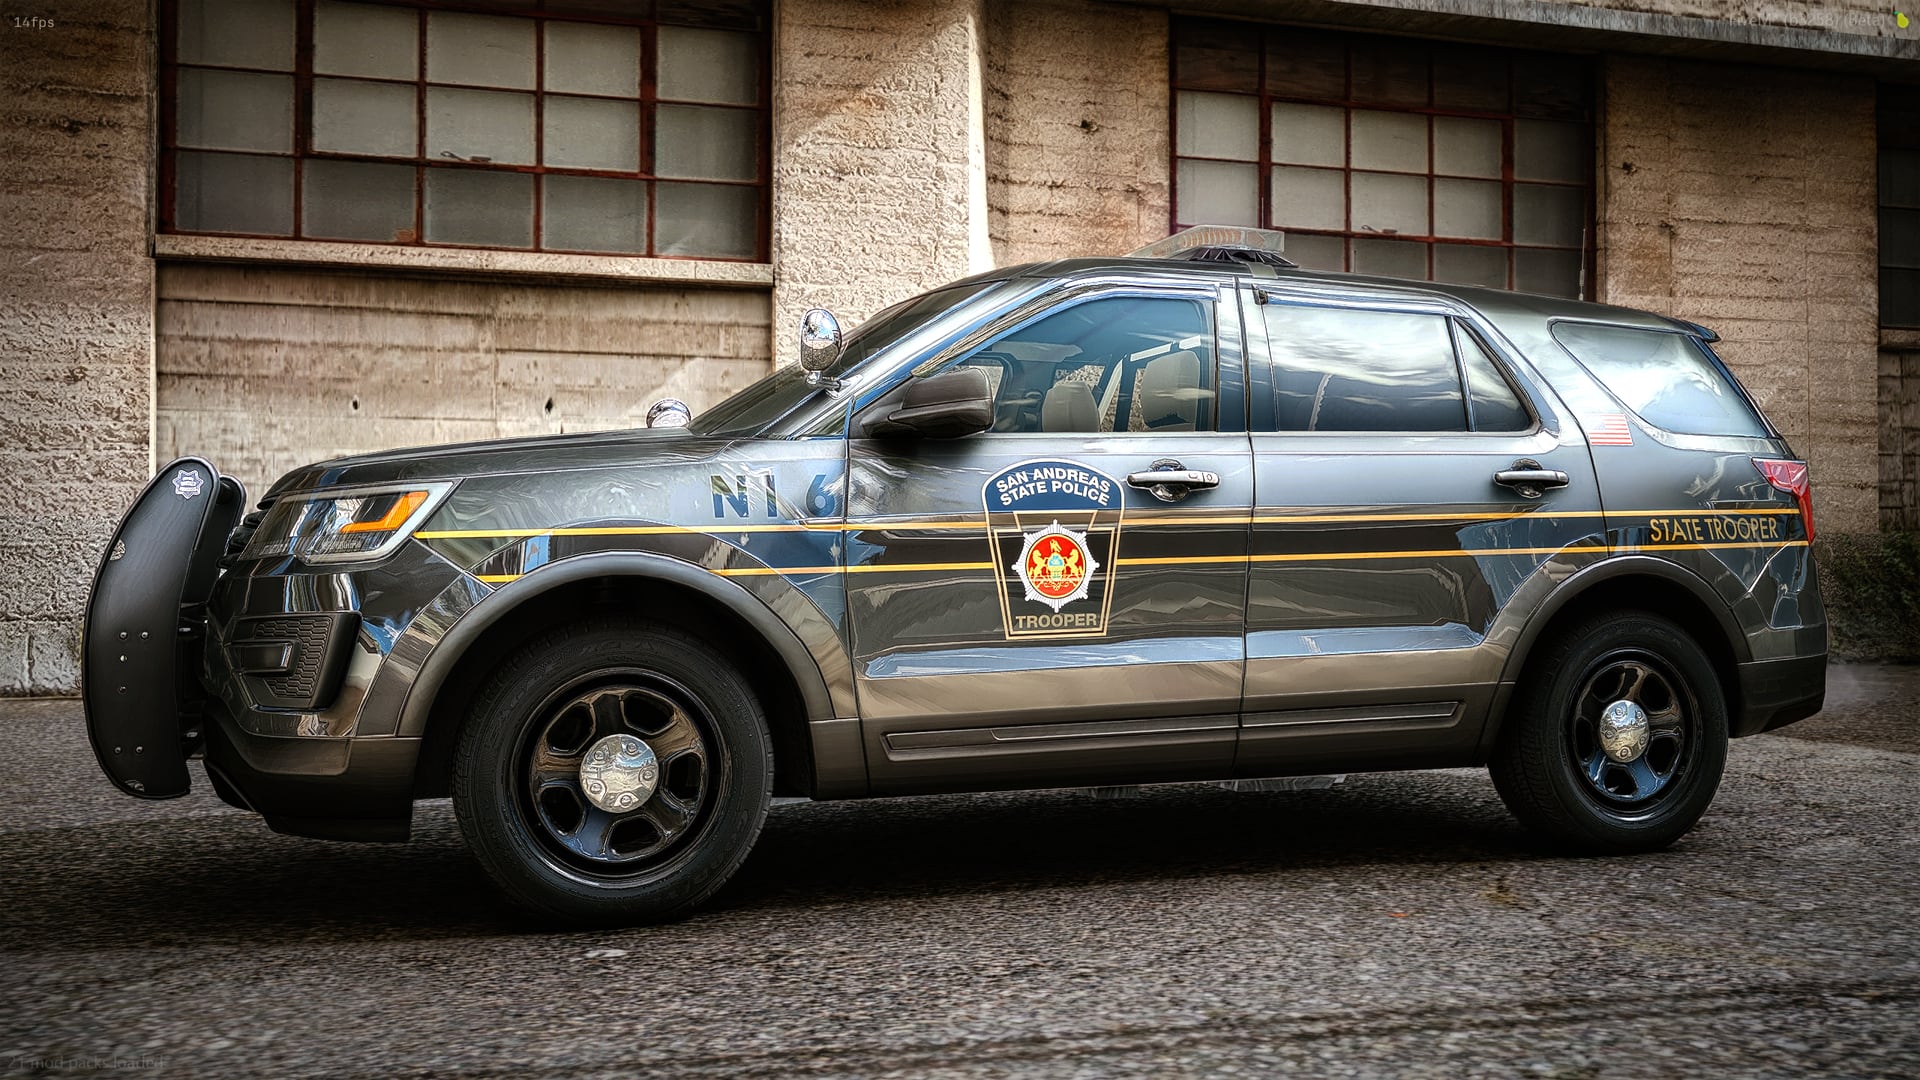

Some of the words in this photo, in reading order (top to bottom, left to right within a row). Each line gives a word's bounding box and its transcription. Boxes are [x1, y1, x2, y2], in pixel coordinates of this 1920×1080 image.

[996, 470, 1029, 494] SAN
[1033, 467, 1111, 493] ANDREAS
[1000, 481, 1048, 506] STATE
[1052, 480, 1110, 507] POLICE
[1650, 517, 1704, 542] STATE
[1704, 517, 1779, 541] TROOPER
[1015, 612, 1097, 629] TROOPER
